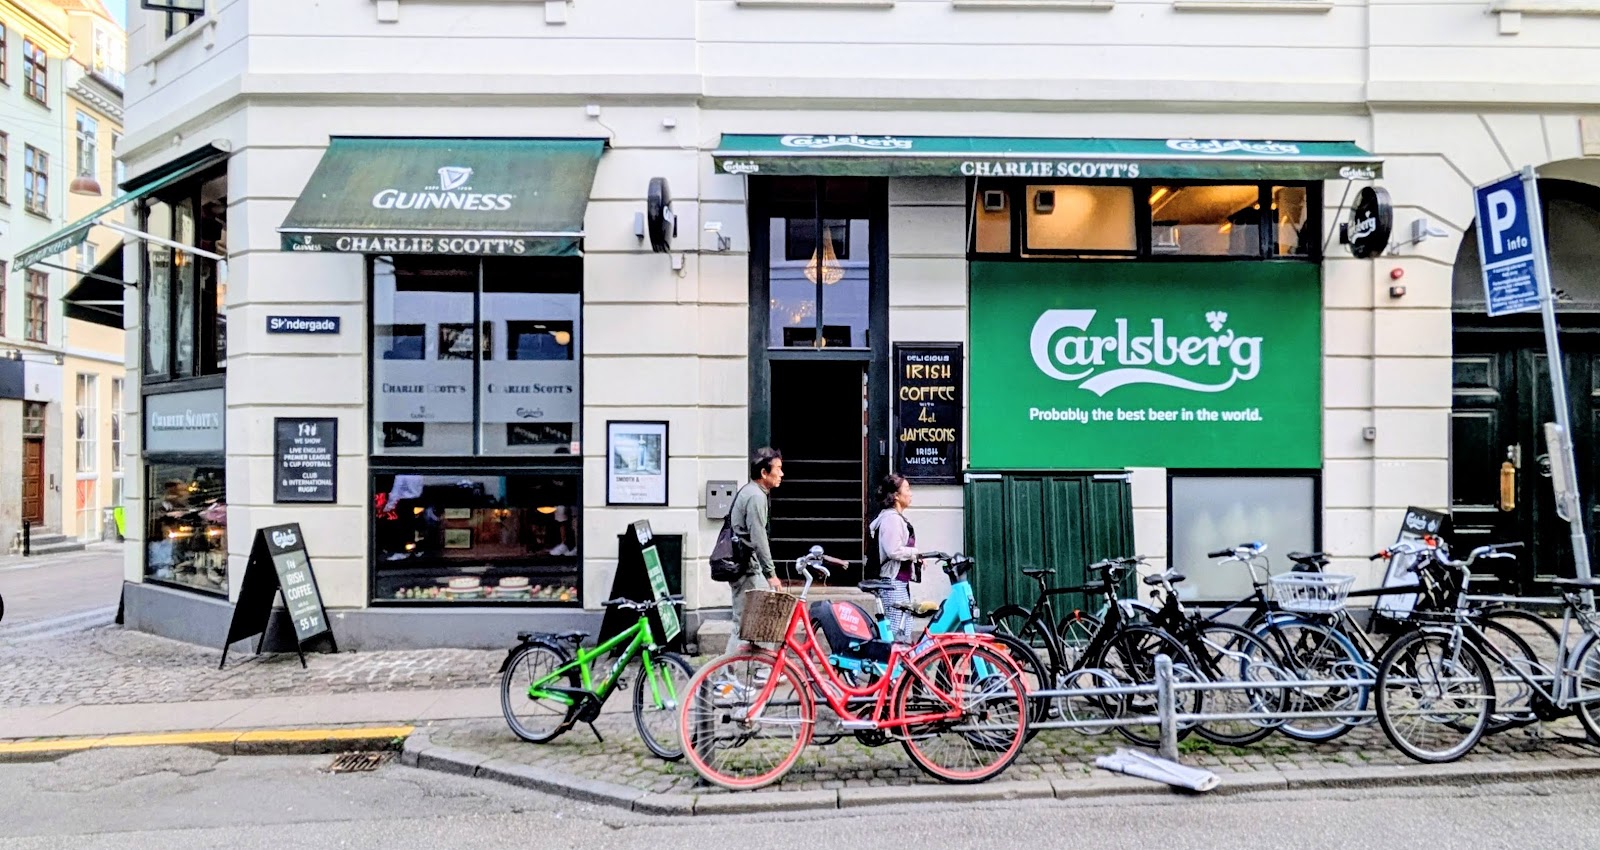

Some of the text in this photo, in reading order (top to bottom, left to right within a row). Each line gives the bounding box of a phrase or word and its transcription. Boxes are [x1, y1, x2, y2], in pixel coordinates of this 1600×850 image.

[780, 135, 914, 149] Carlsberg
[1166, 139, 1300, 154] Carlsberg
[722, 160, 759, 174] Carlsberg
[960, 161, 1140, 178] CHARLIE SCOTT'S
[1339, 166, 1375, 180] Carlsberg
[372, 189, 512, 211] GUINNESS
[1487, 189, 1517, 255] P
[293, 243, 322, 251] GUINNESS
[336, 236, 526, 254] CHARLIE SCOTT'S
[1507, 235, 1528, 251] info
[1030, 309, 1263, 396] Carlsberg
[906, 364, 951, 379] IRISH
[382, 383, 424, 393] CHARLIE
[487, 383, 573, 394] CRLIE SCOTT'S
[900, 386, 955, 401] COFFEE
[152, 411, 184, 429] CHARLIE
[1030, 407, 1263, 424] Probably the best beer in the world.
[900, 428, 955, 442] JAMESONS
[916, 448, 938, 456] IRISH
[905, 457, 947, 465] WHISKEY
[286, 571, 305, 586] IRISH
[287, 584, 313, 601] COFFEE
[300, 616, 318, 630] 55 kr
